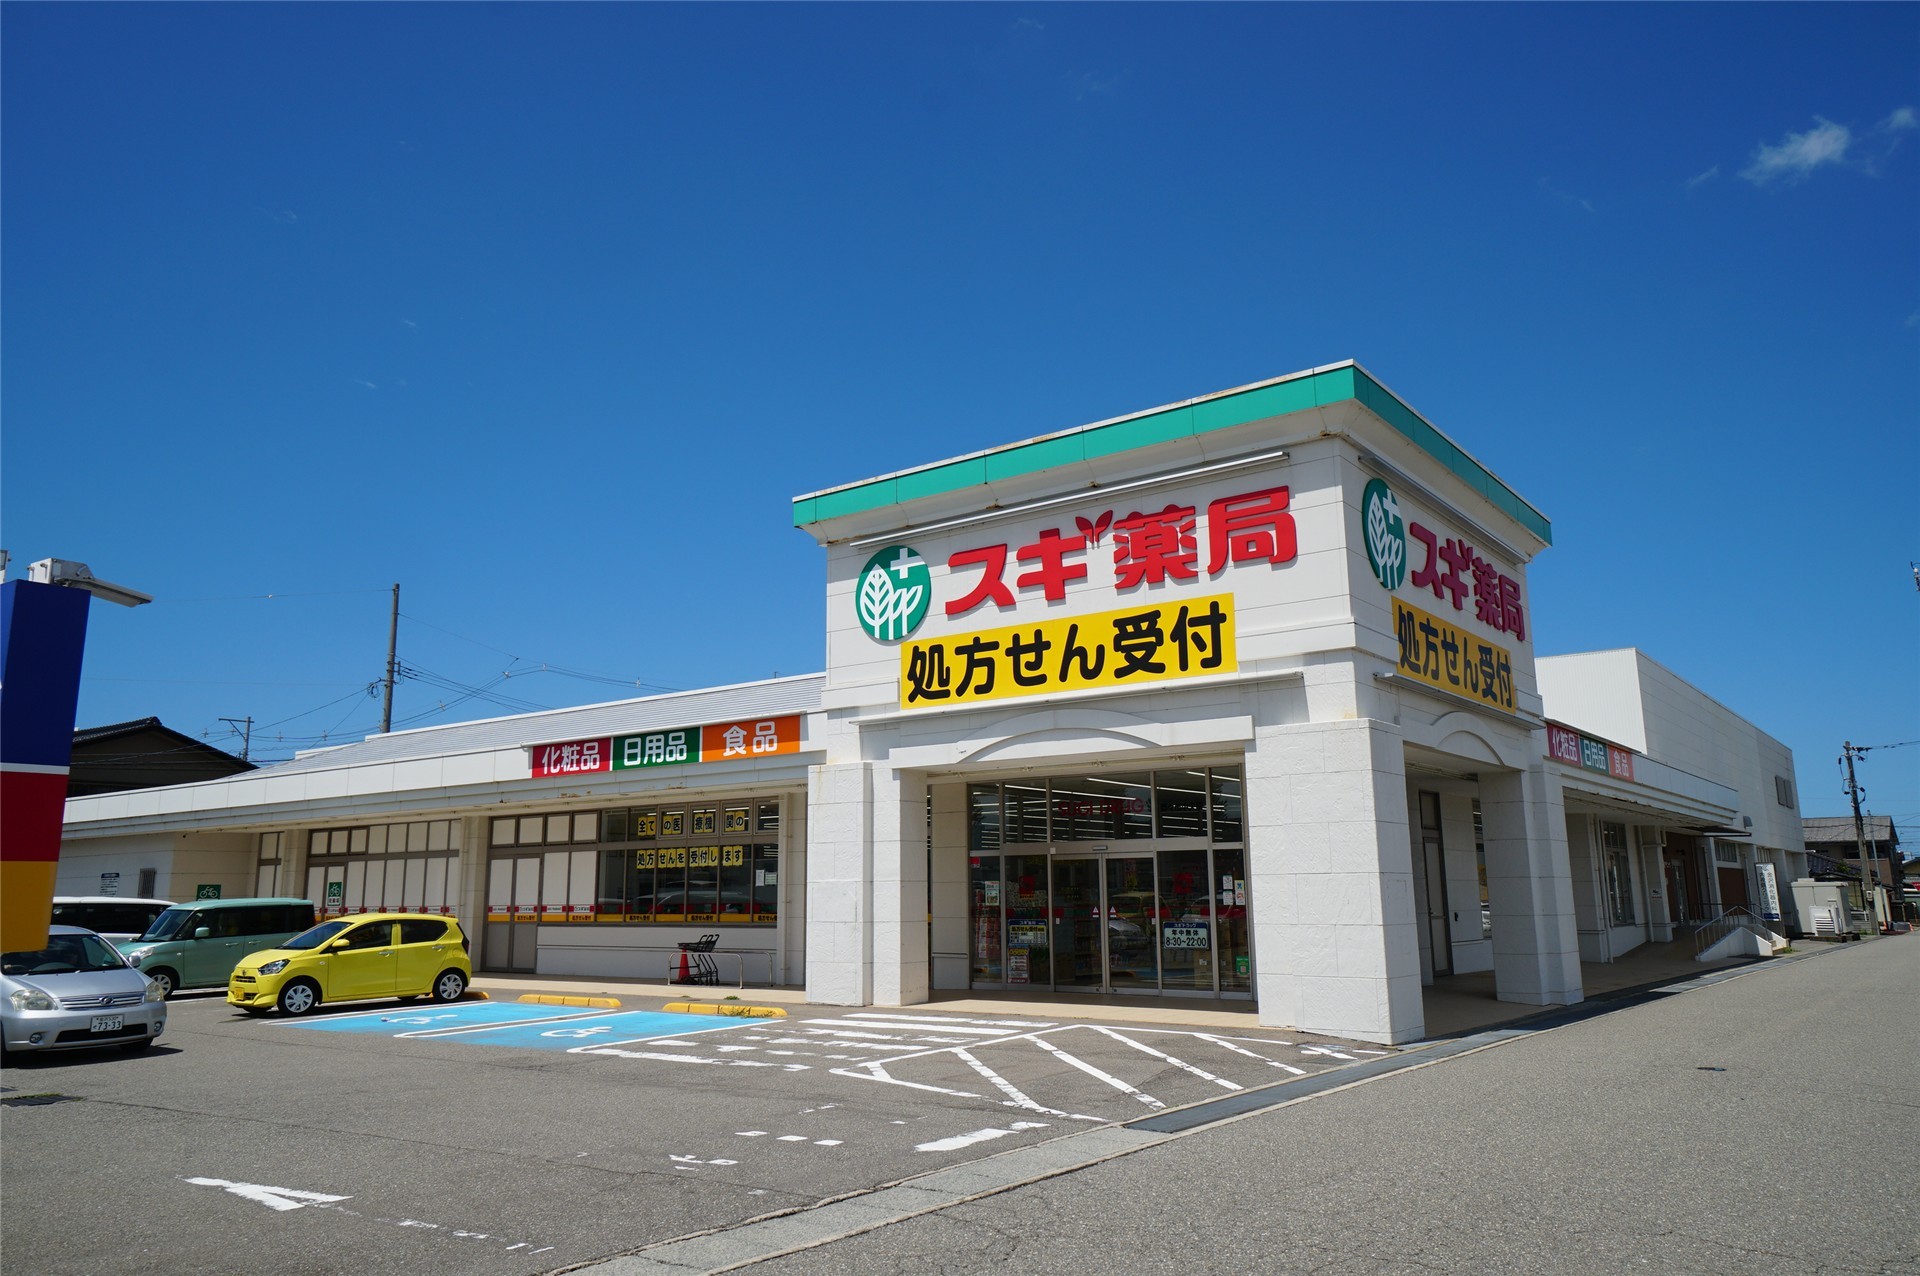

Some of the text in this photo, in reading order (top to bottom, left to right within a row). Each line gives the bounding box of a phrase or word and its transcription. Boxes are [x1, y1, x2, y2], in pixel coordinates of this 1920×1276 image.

[944, 485, 1298, 616] スギ薬局
[1410, 521, 1526, 642] スギ薬局
[907, 600, 1228, 703] 処方せん受付
[1397, 604, 1513, 709] 処方せん受付
[541, 720, 779, 775] 化粧品 日用品 食品
[1552, 728, 1630, 778] 化粧品 日用品 食品
[637, 849, 742, 867] 処方せんを受付します
[1171, 929, 1199, 937] 年中無休
